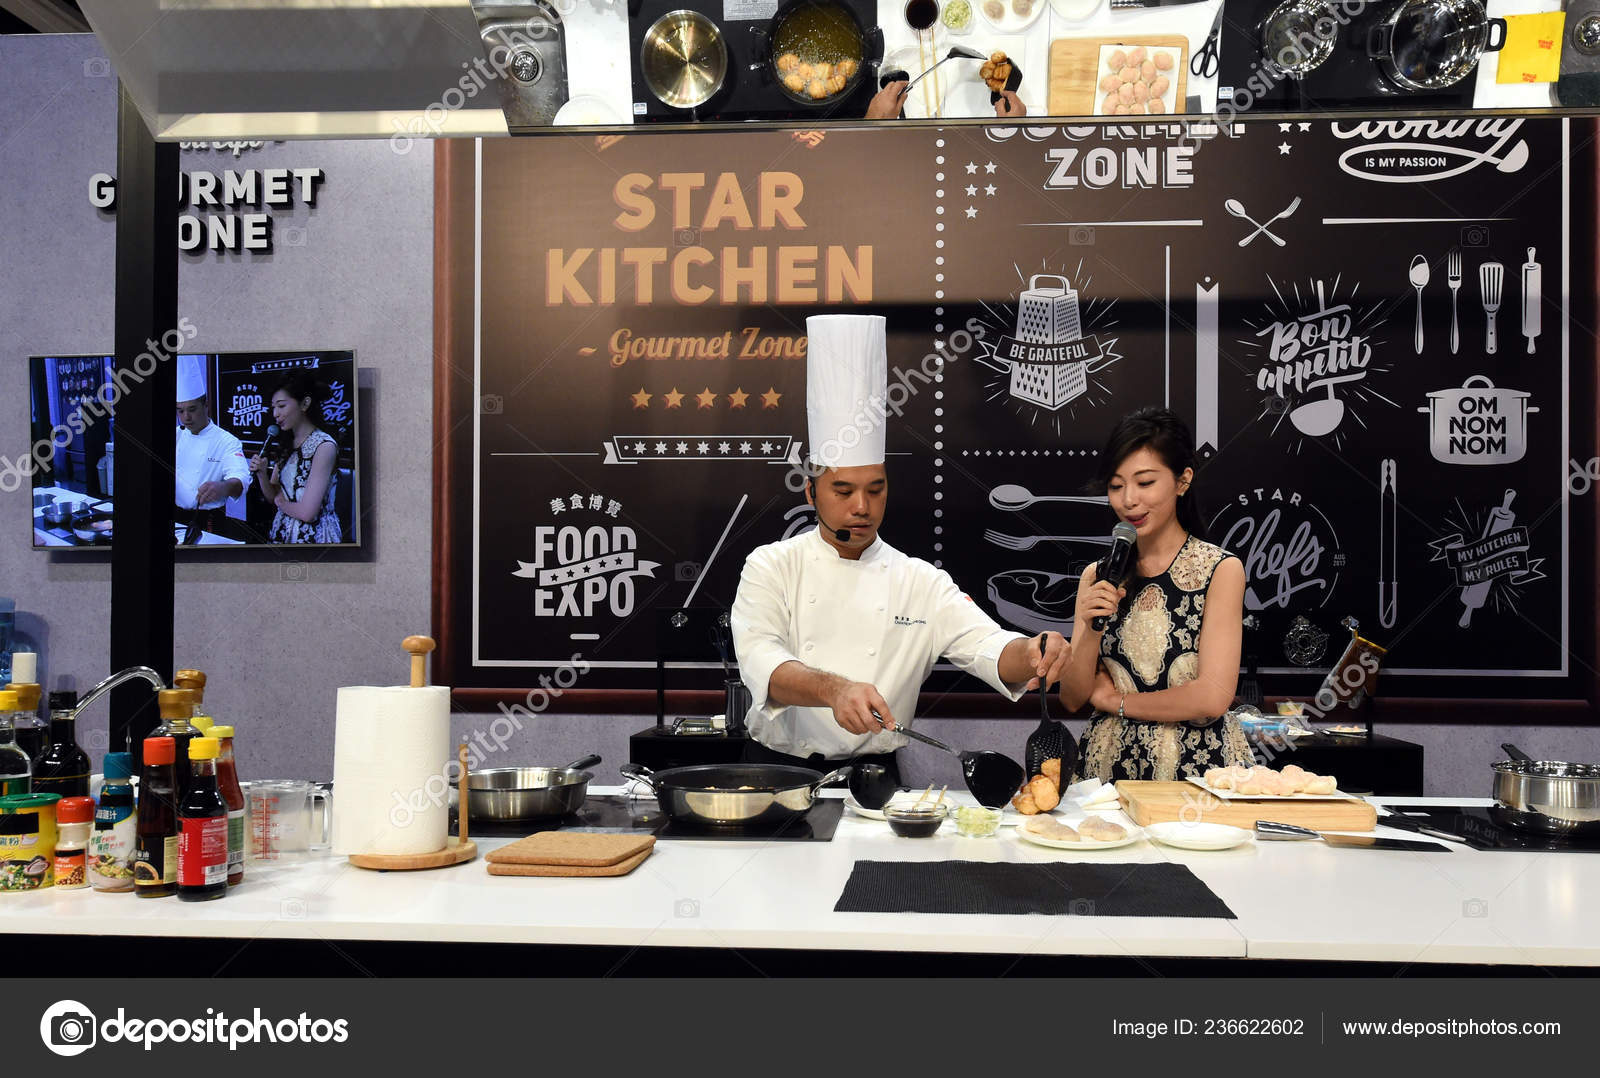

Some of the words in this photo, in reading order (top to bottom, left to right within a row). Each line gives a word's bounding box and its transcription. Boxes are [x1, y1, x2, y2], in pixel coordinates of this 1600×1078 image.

[1044, 147, 1194, 190] ZONE
[1365, 157, 1375, 167] IS
[1379, 157, 1396, 167] MY
[1399, 157, 1447, 167] PASSION
[89, 168, 322, 208] GRMET
[613, 171, 807, 231] STAR
[178, 213, 270, 250] ONE
[546, 245, 874, 307] KITCHEN
[608, 328, 733, 368] Gourmet
[738, 327, 808, 360] Zone
[1009, 343, 1026, 359] BE
[1028, 343, 1089, 361] GRATEFUL
[1256, 314, 1351, 362] Bon
[232, 395, 263, 410] FOOD
[1458, 396, 1497, 414] OM
[233, 411, 262, 427] EXPO
[1449, 416, 1506, 434] NOM
[1449, 436, 1506, 454] NOM
[550, 493, 622, 518] 美食博覽
[1238, 488, 1302, 506] STAR
[535, 525, 637, 568] FOOD
[1457, 549, 1474, 562] MY
[1475, 532, 1522, 557] KITCHEN
[1465, 568, 1481, 582] MY
[1485, 556, 1519, 576] RULES
[535, 574, 635, 618] EXPO
